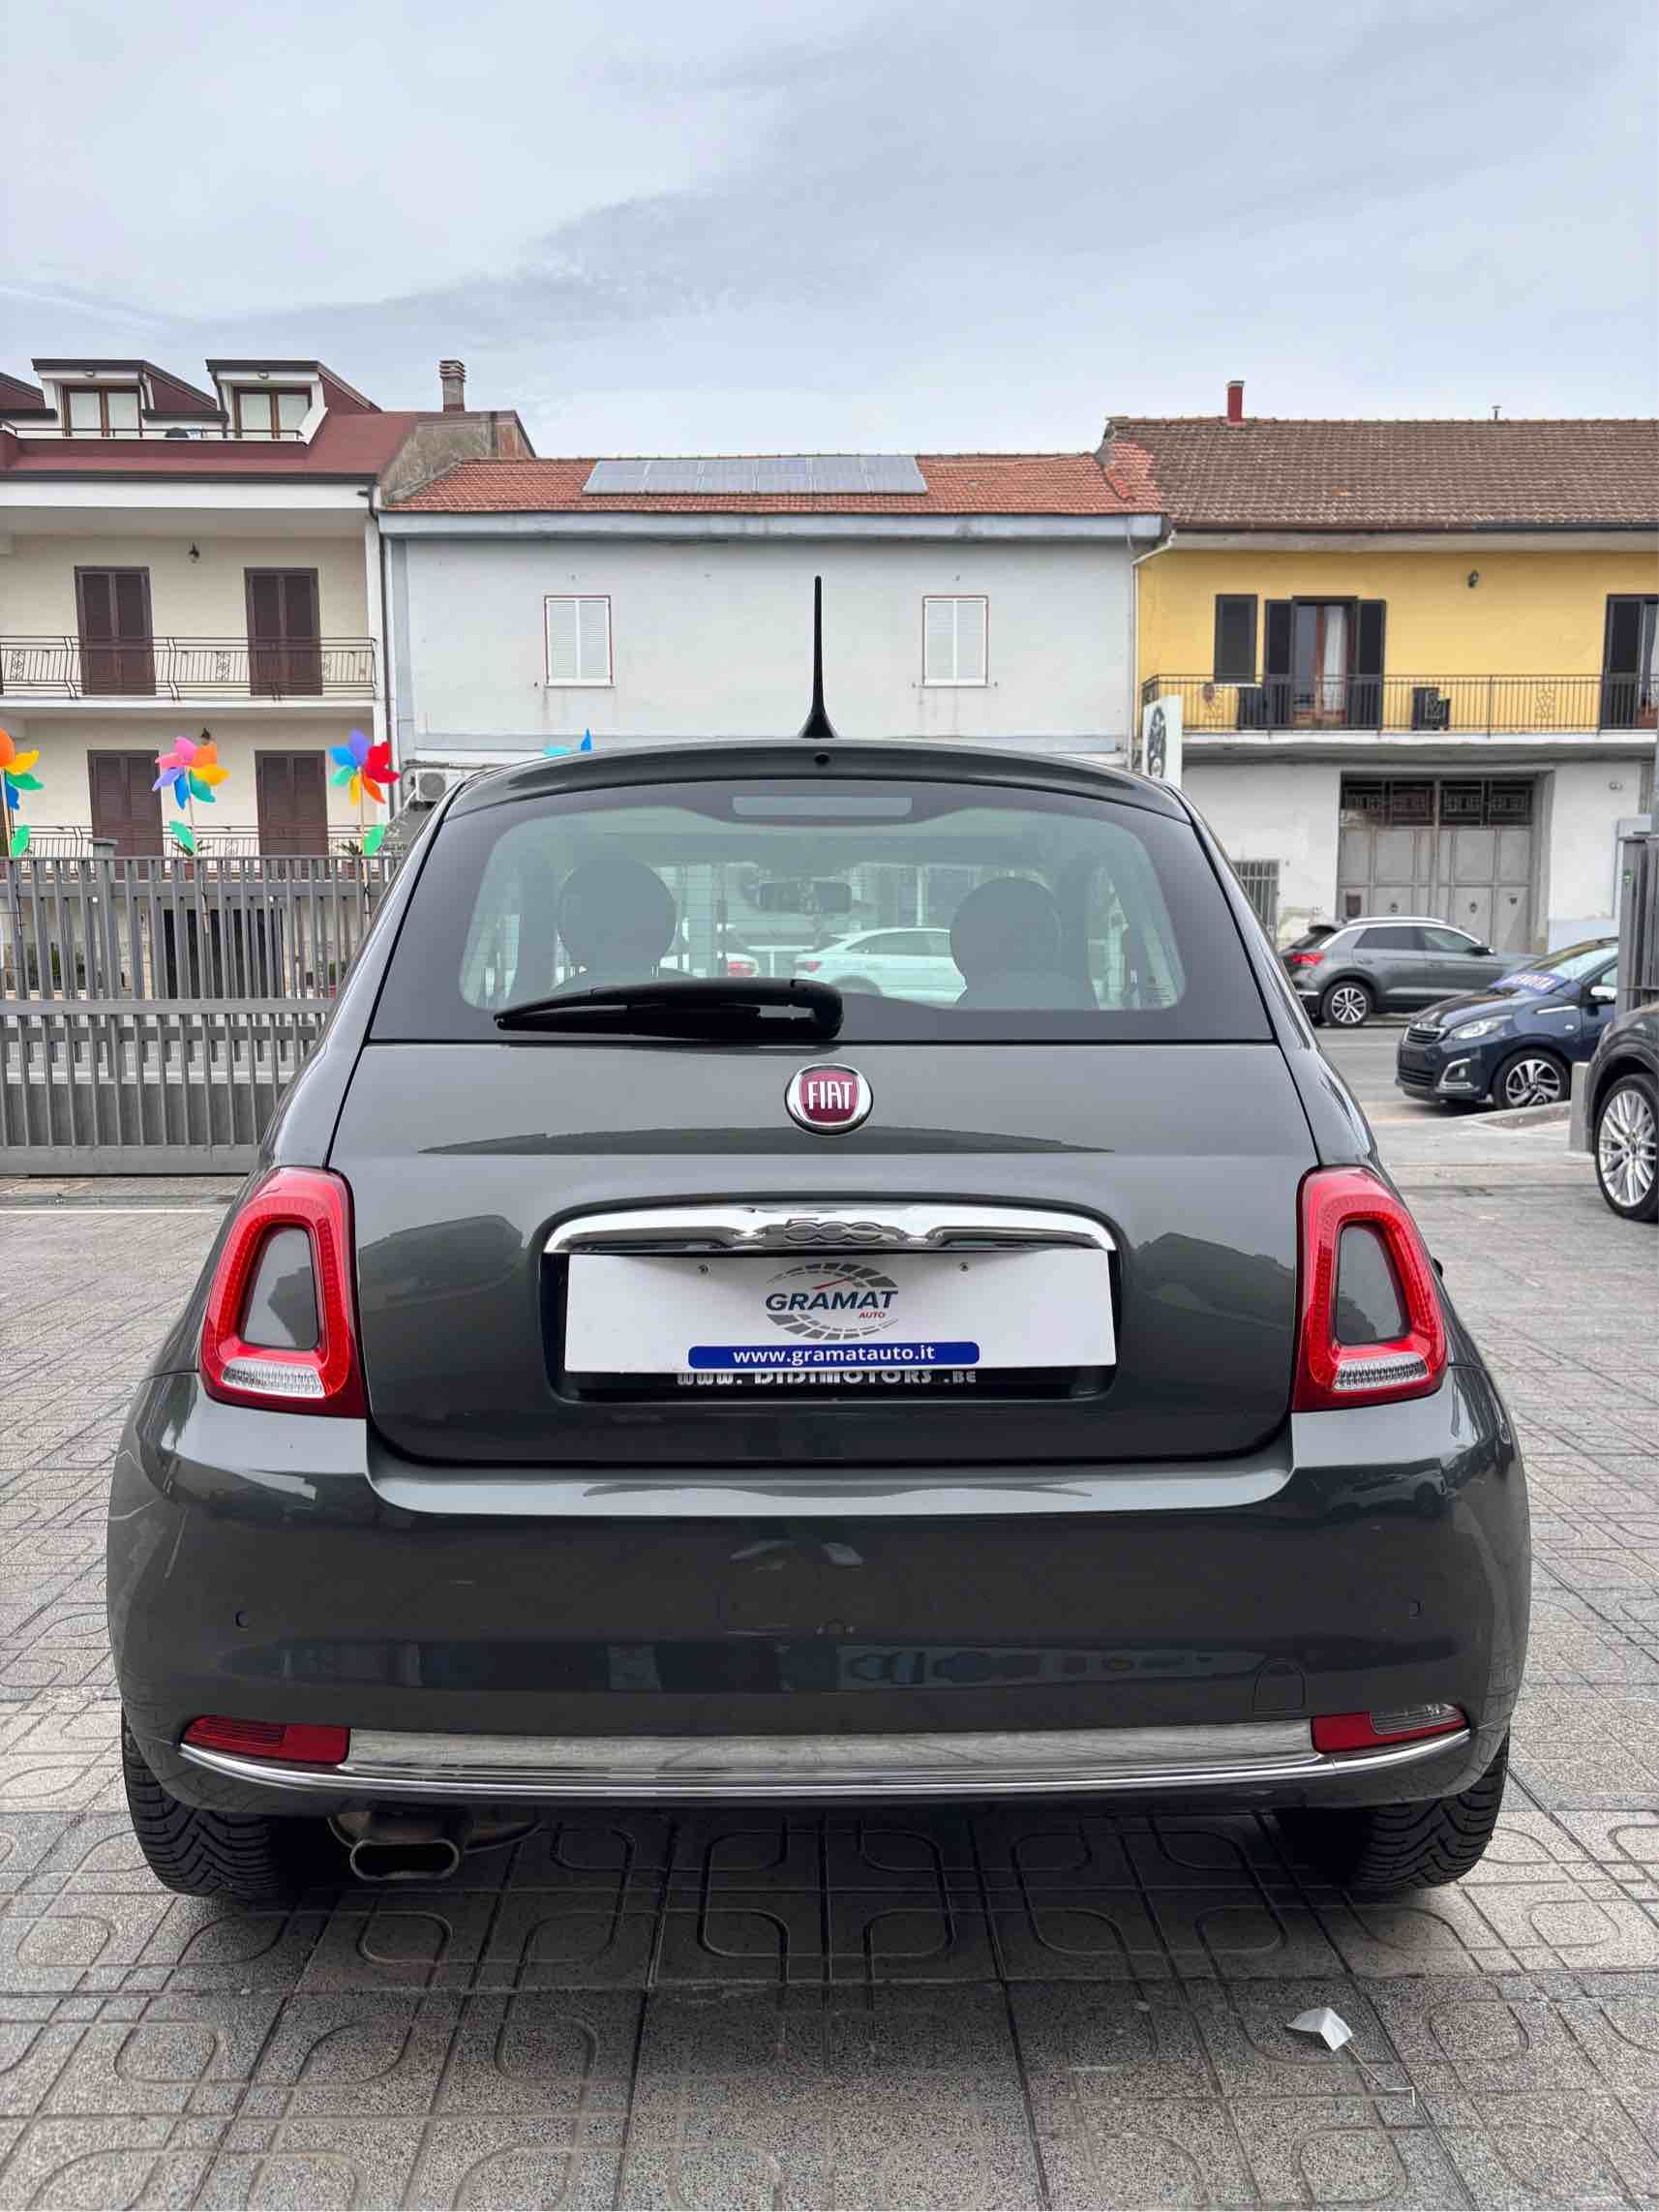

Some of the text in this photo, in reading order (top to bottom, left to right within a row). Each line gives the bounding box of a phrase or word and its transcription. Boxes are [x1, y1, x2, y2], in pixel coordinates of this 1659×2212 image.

[807, 1080, 853, 1110] FIAT
[765, 1290, 899, 1312] GRAMAT
[859, 1311, 886, 1319] AUTO
[732, 1345, 936, 1366] www.gramatauto.it
